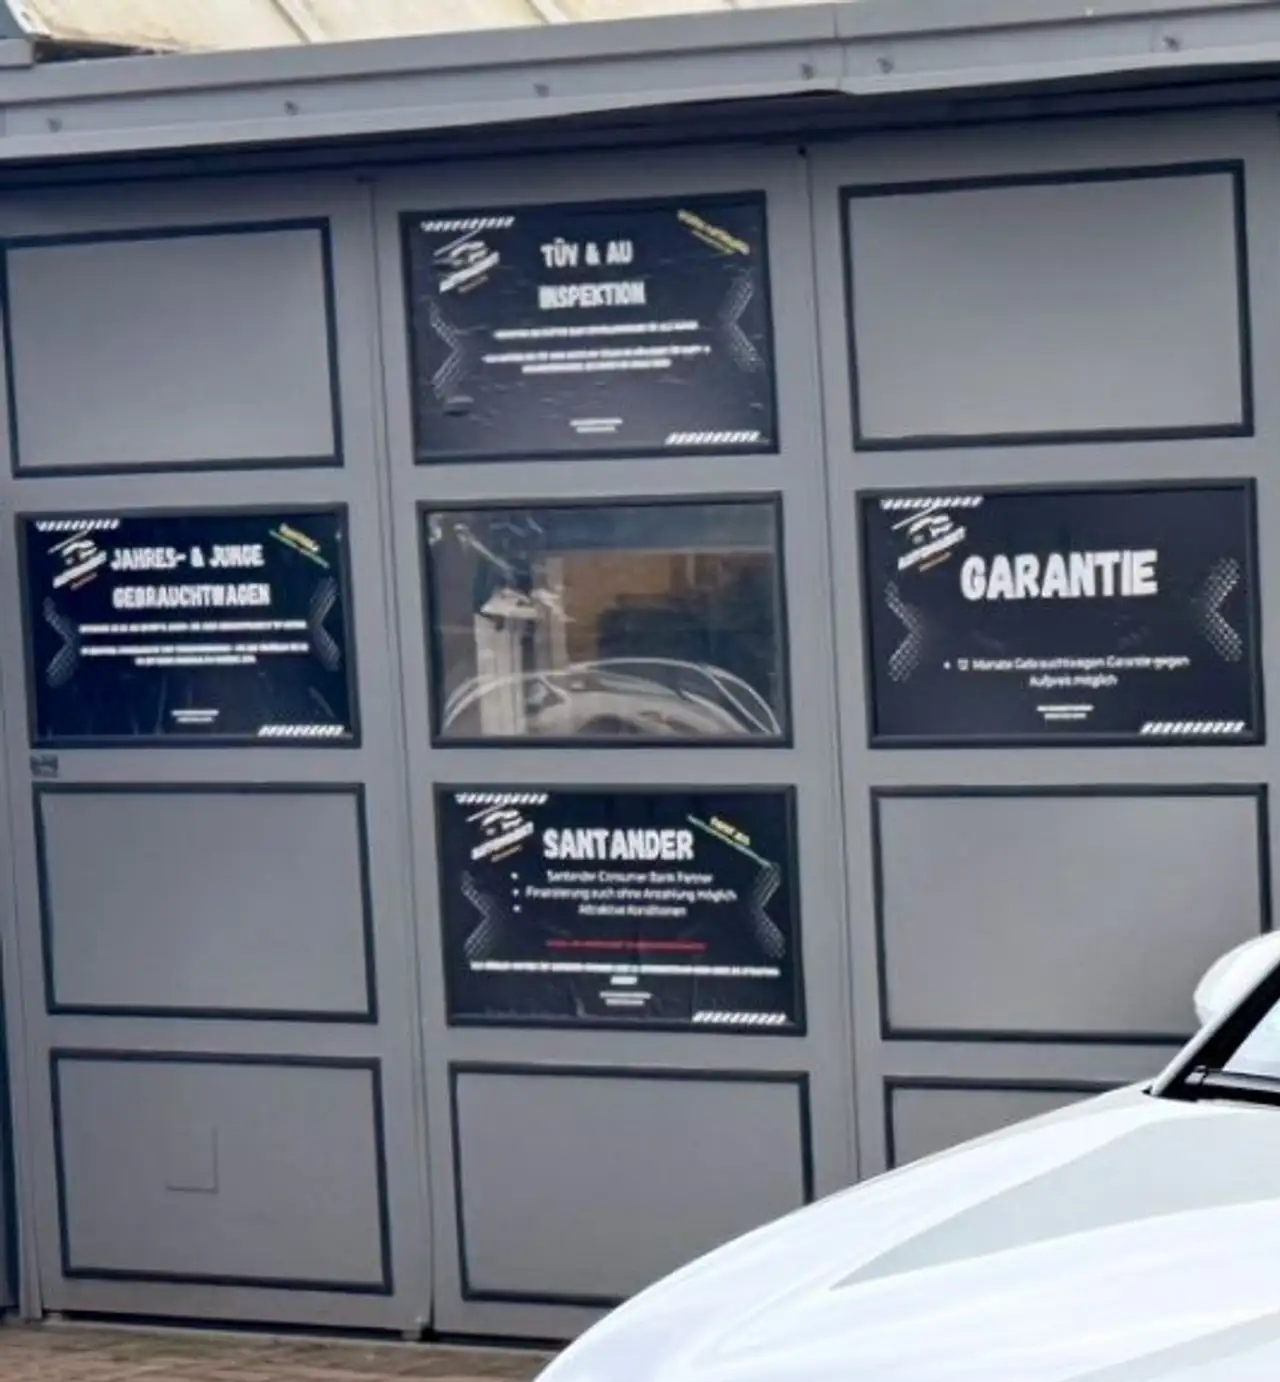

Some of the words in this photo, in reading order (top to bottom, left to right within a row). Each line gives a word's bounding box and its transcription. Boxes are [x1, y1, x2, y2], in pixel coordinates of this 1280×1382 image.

[540, 237, 579, 268] TÜV
[585, 242, 600, 266] &
[606, 240, 633, 265] AU
[538, 281, 646, 310] INSPEKTION
[110, 546, 187, 571] JAHRES-
[190, 545, 205, 568] &
[209, 544, 265, 569] JUNGE
[960, 549, 1158, 602] GARANTIE
[112, 583, 272, 610] GEBRAUCHTWAGEN
[542, 828, 695, 861] SANTANDER
